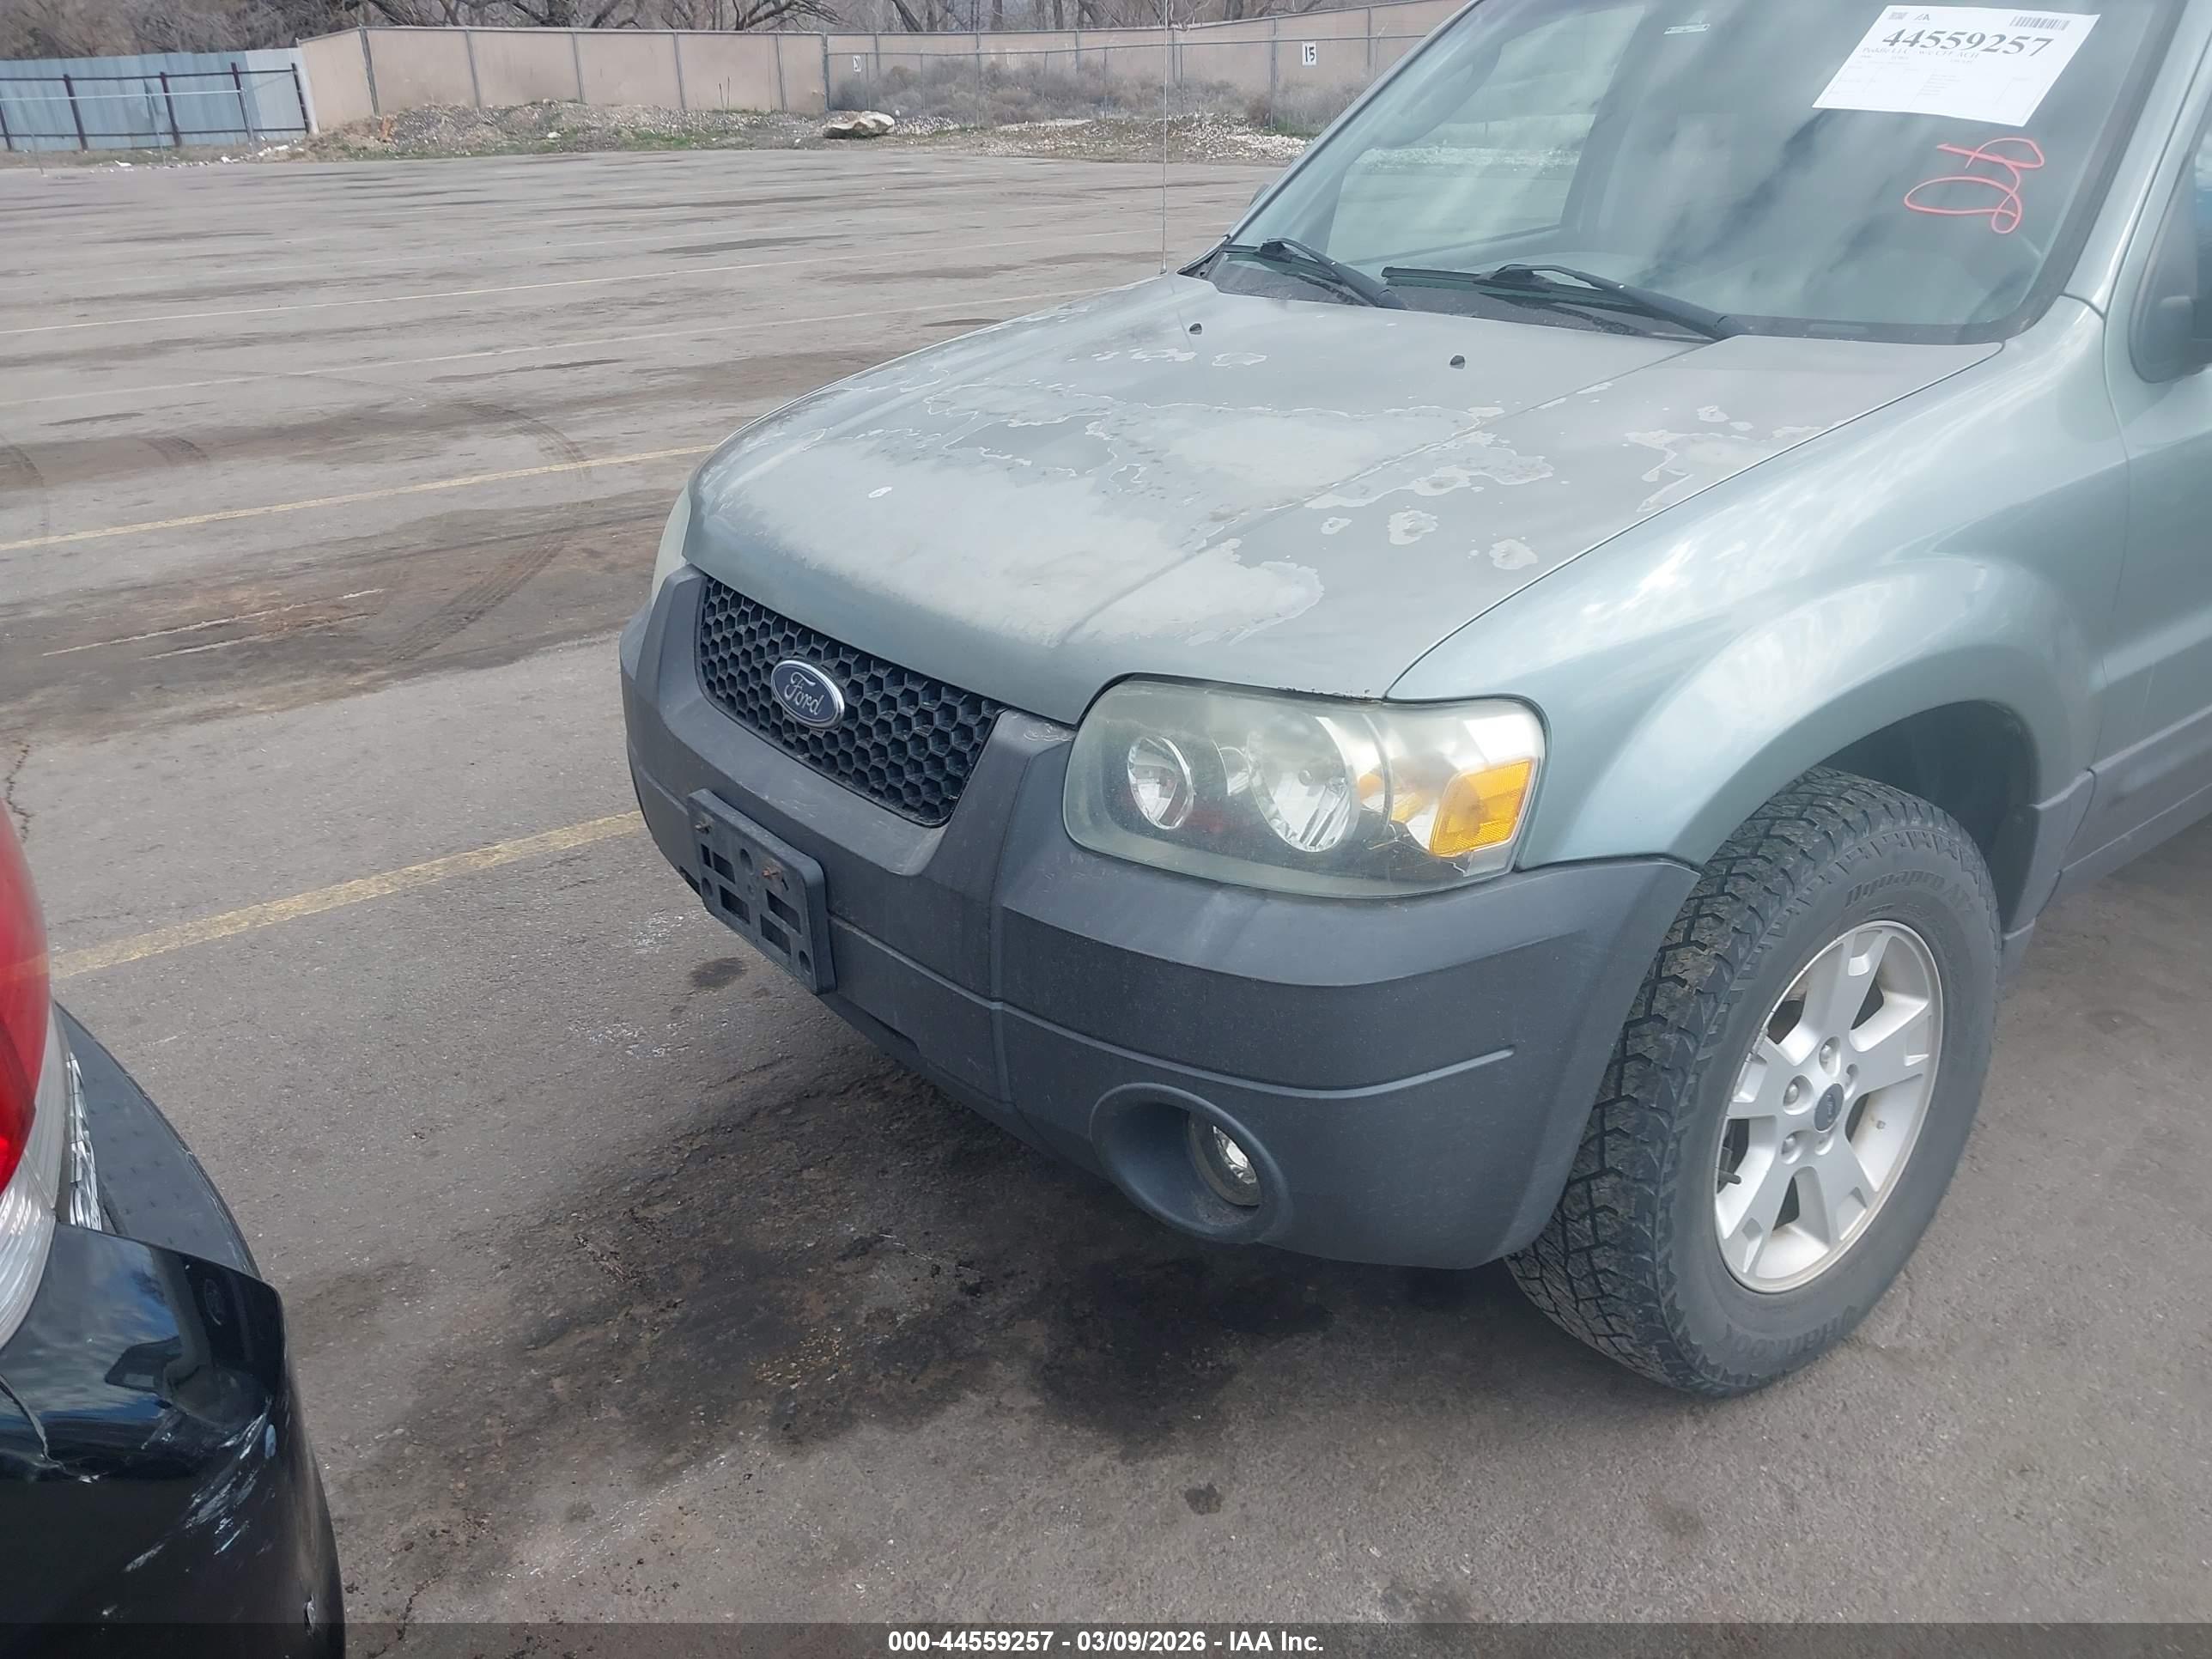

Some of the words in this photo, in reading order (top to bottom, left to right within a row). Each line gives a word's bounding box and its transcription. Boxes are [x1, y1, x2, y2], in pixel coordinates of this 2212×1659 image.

[1304, 46, 1316, 63] 15
[1881, 28, 2054, 57] 44559257
[784, 671, 824, 716] Ford
